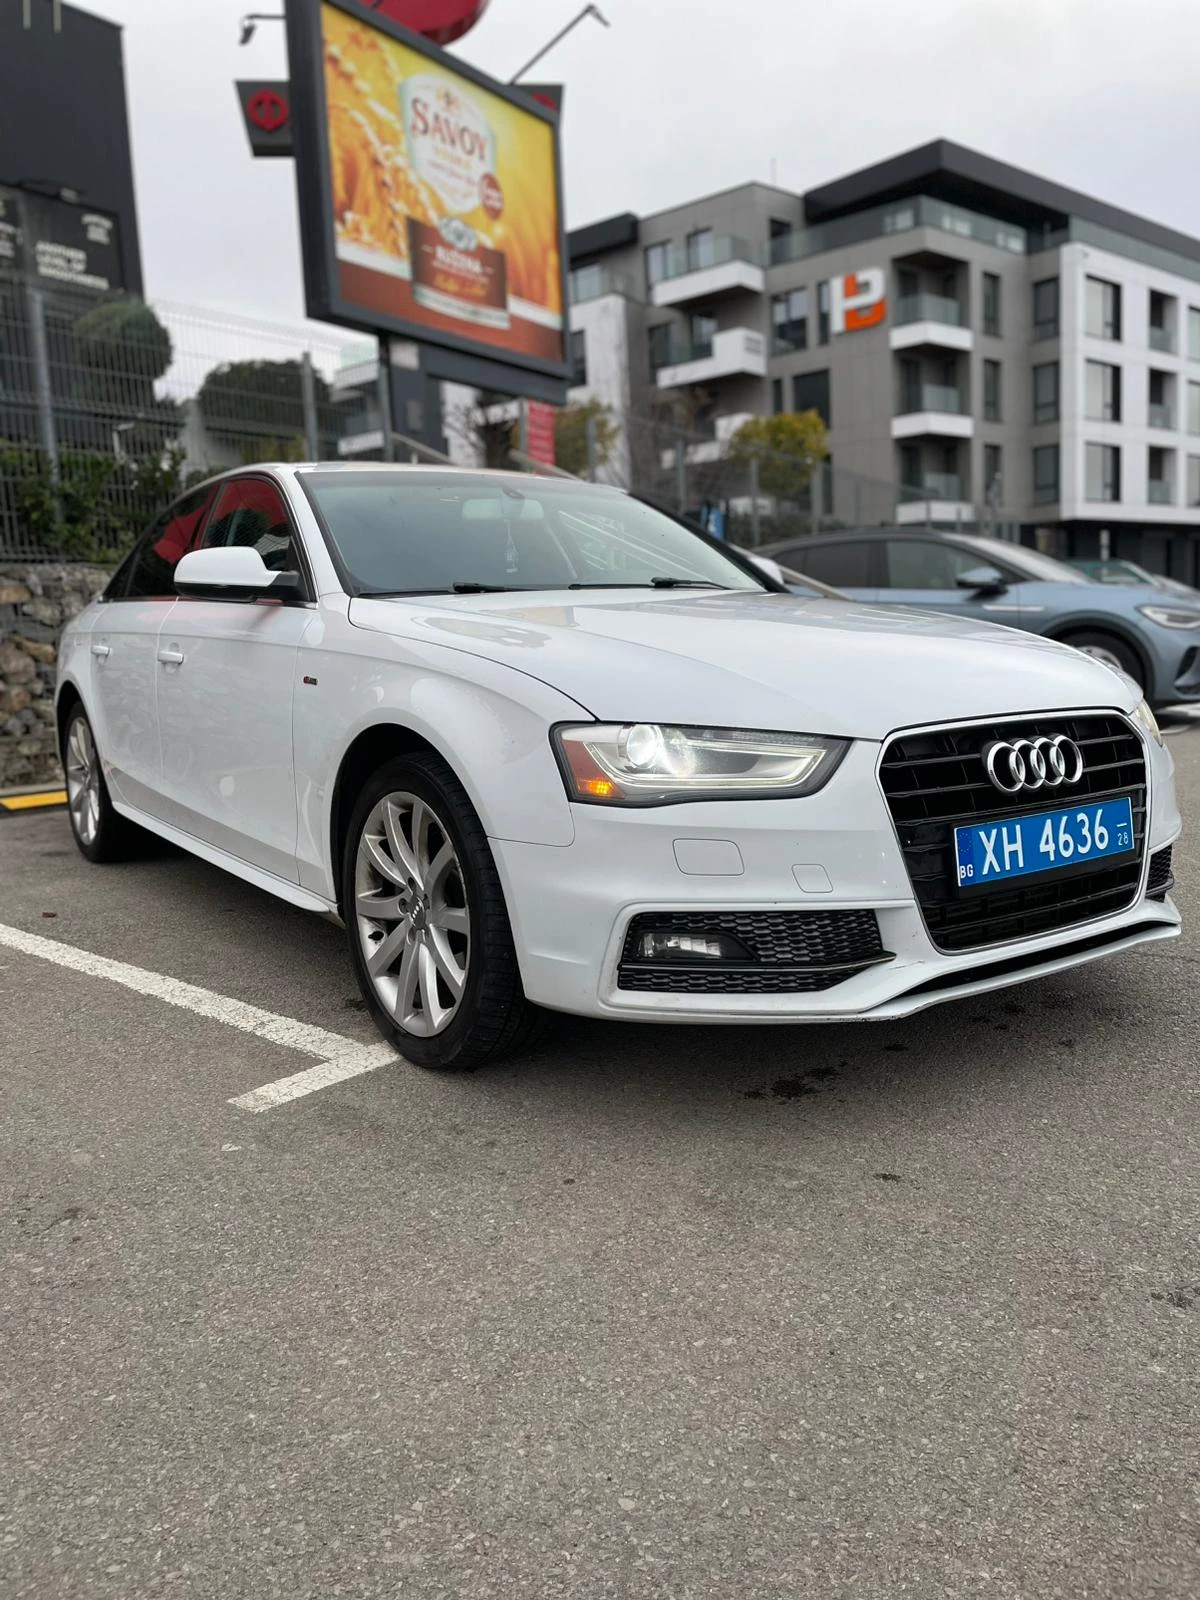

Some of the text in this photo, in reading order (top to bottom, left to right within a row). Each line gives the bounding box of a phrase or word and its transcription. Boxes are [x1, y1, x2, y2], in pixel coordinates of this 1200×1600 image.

[411, 97, 488, 161] SAVOY
[960, 808, 1129, 879] BG XH 4636 28
